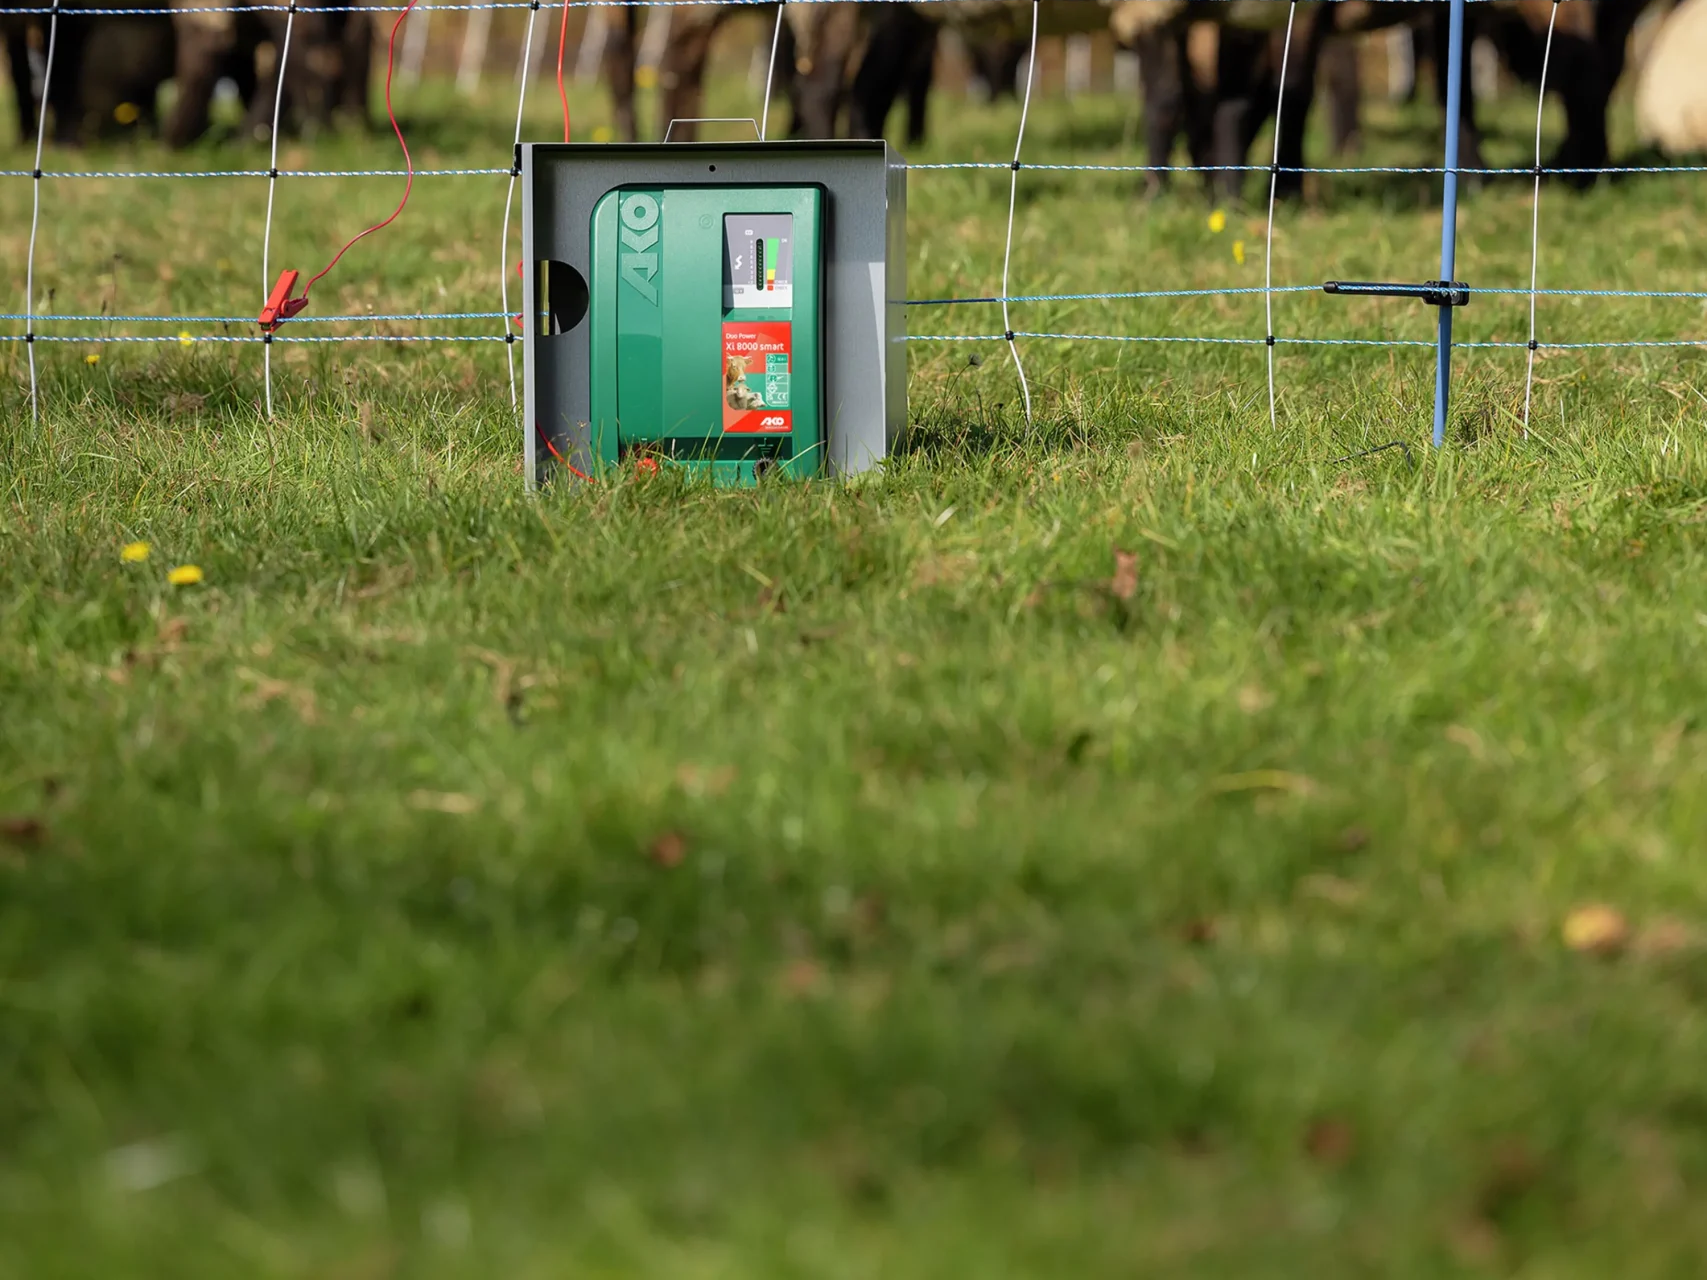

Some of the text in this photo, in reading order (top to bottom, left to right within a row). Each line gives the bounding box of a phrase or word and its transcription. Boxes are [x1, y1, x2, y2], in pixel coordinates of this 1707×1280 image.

[621, 193, 660, 308] AKO
[737, 342, 758, 351] 8000
[760, 343, 784, 351] smart
[760, 417, 785, 426] AKO
